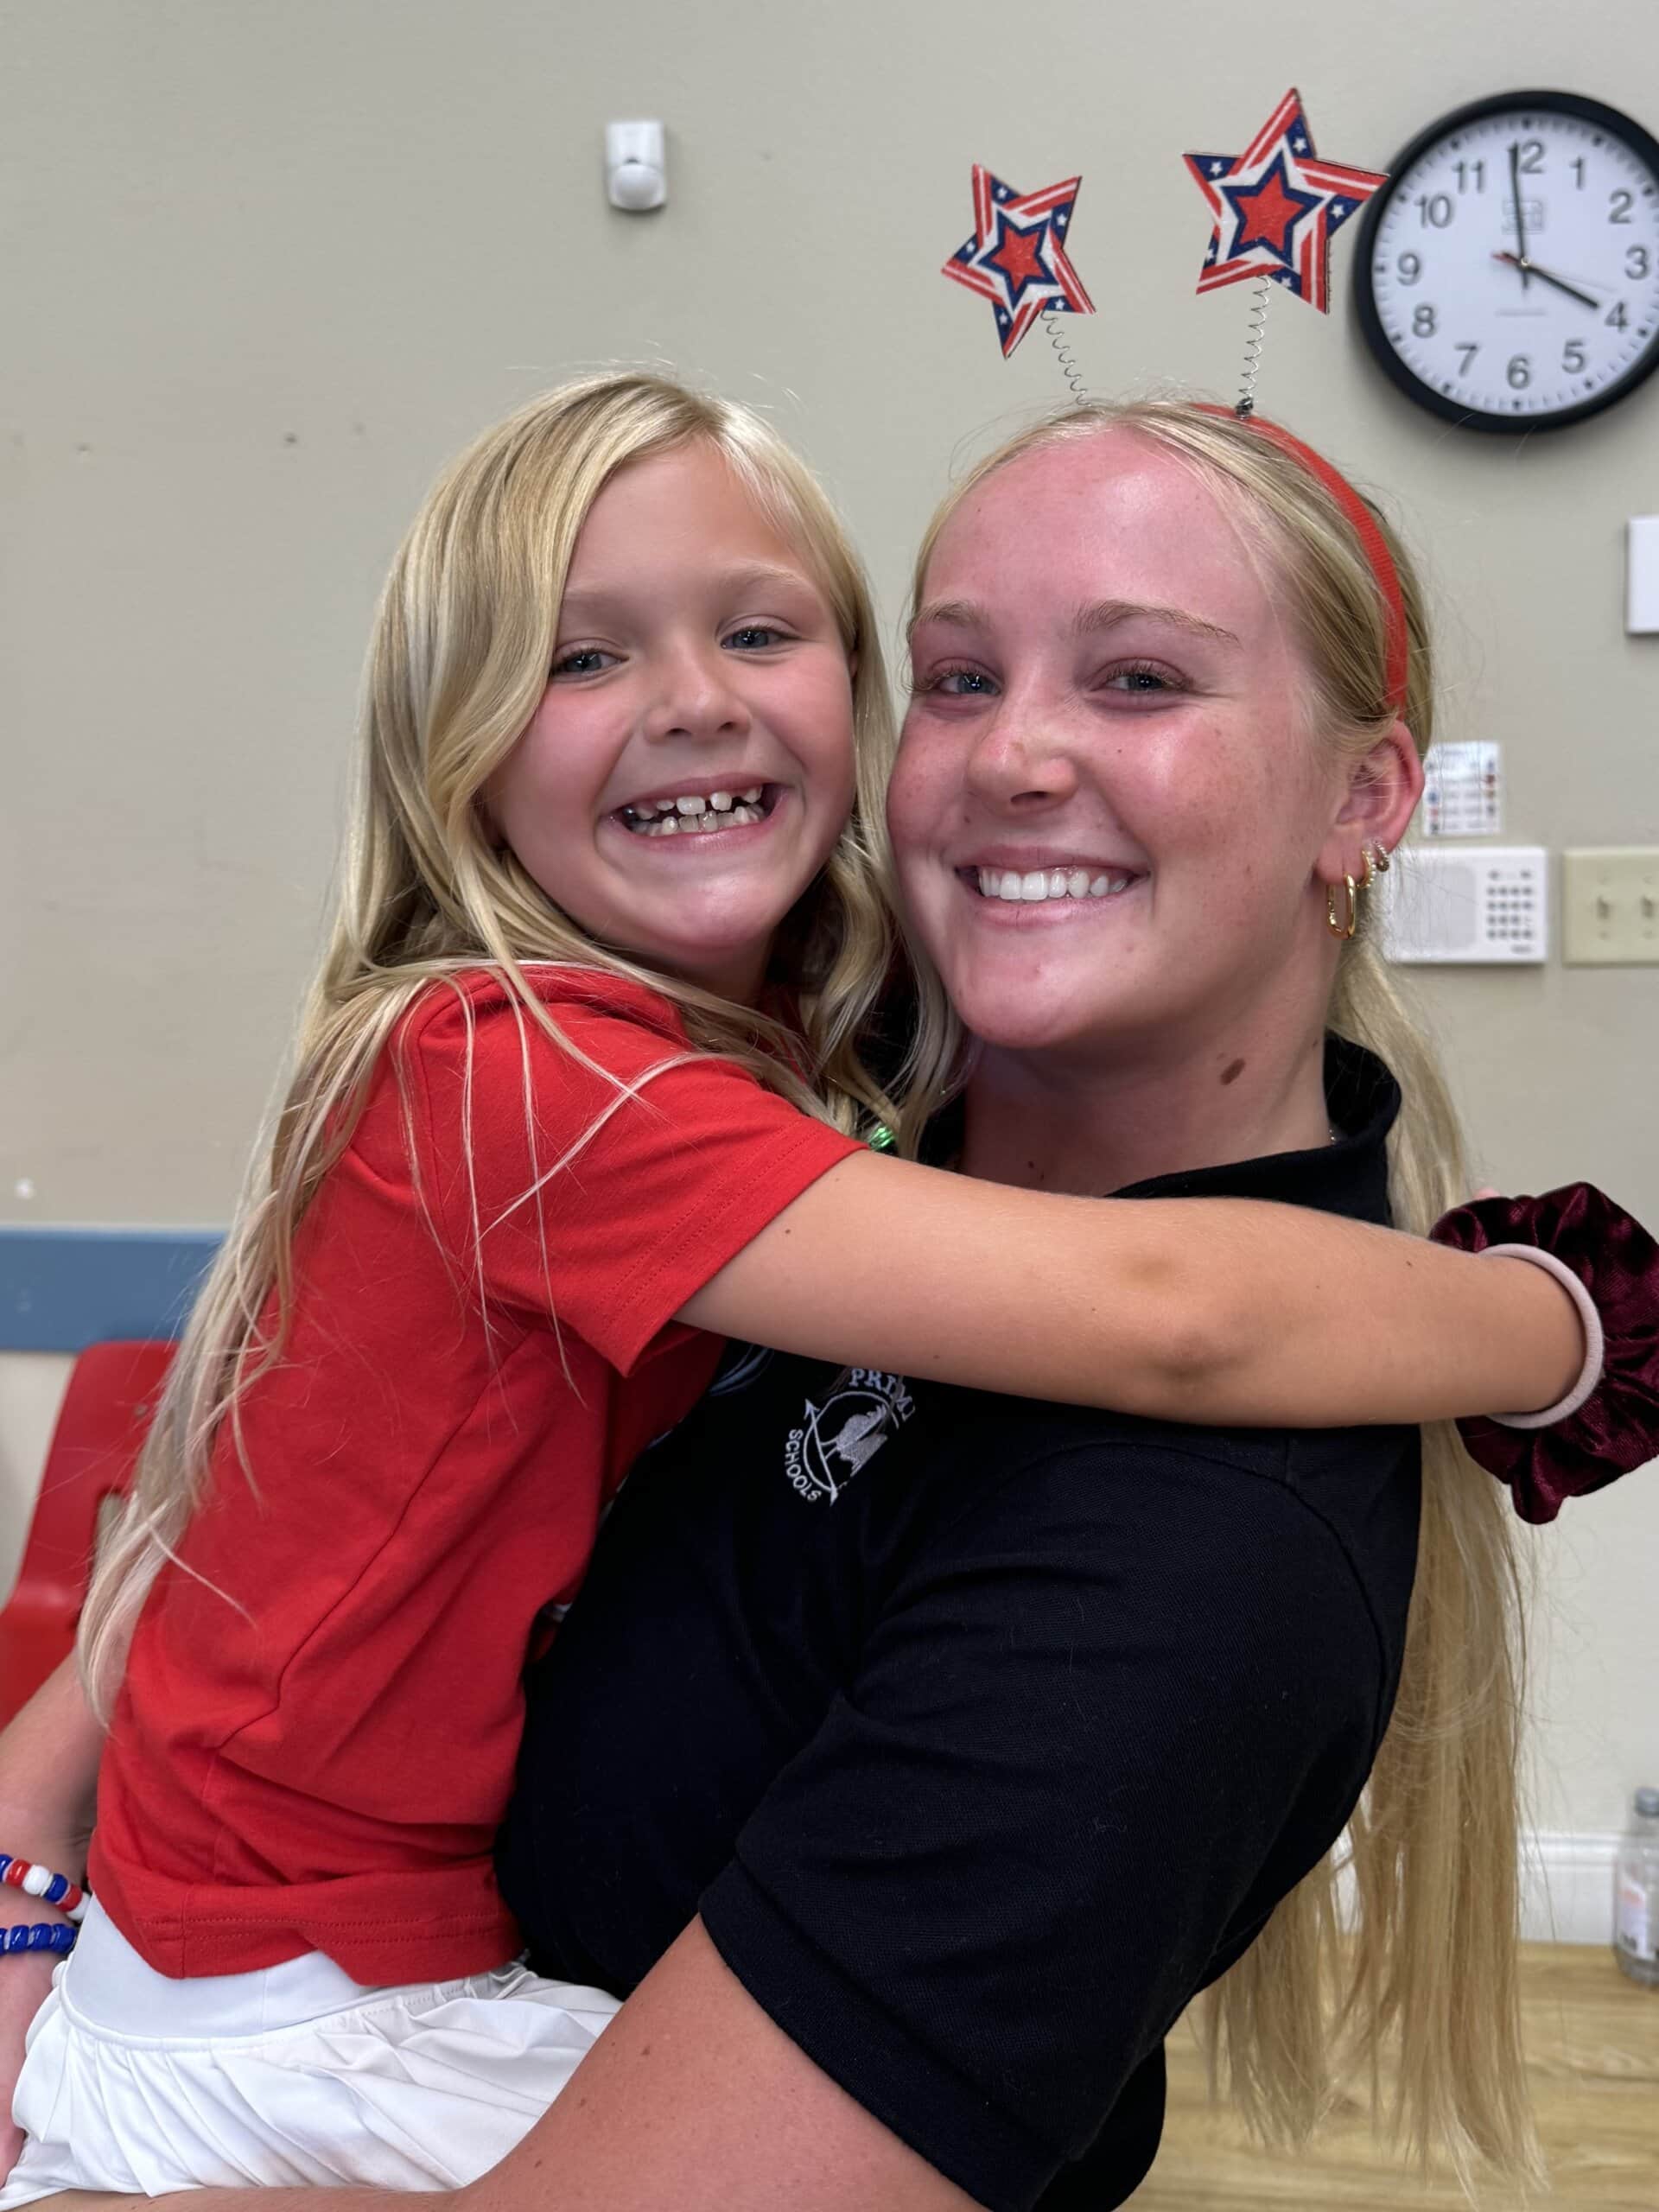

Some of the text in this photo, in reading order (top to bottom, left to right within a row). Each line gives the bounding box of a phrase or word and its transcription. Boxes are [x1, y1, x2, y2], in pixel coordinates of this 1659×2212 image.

[1508, 139, 1545, 175] 2
[1570, 157, 1584, 189] 1
[1452, 161, 1485, 194] 11
[1414, 194, 1453, 228] 10
[1608, 190, 1633, 225] 2
[1396, 252, 1421, 286] 9
[1624, 245, 1649, 280] 3
[1412, 304, 1436, 338] 8
[1605, 301, 1630, 334] 4
[1454, 342, 1480, 378] 7
[1505, 355, 1529, 391] 6
[1561, 340, 1585, 374] 5
[784, 1428, 823, 1503] SCHOOLS
